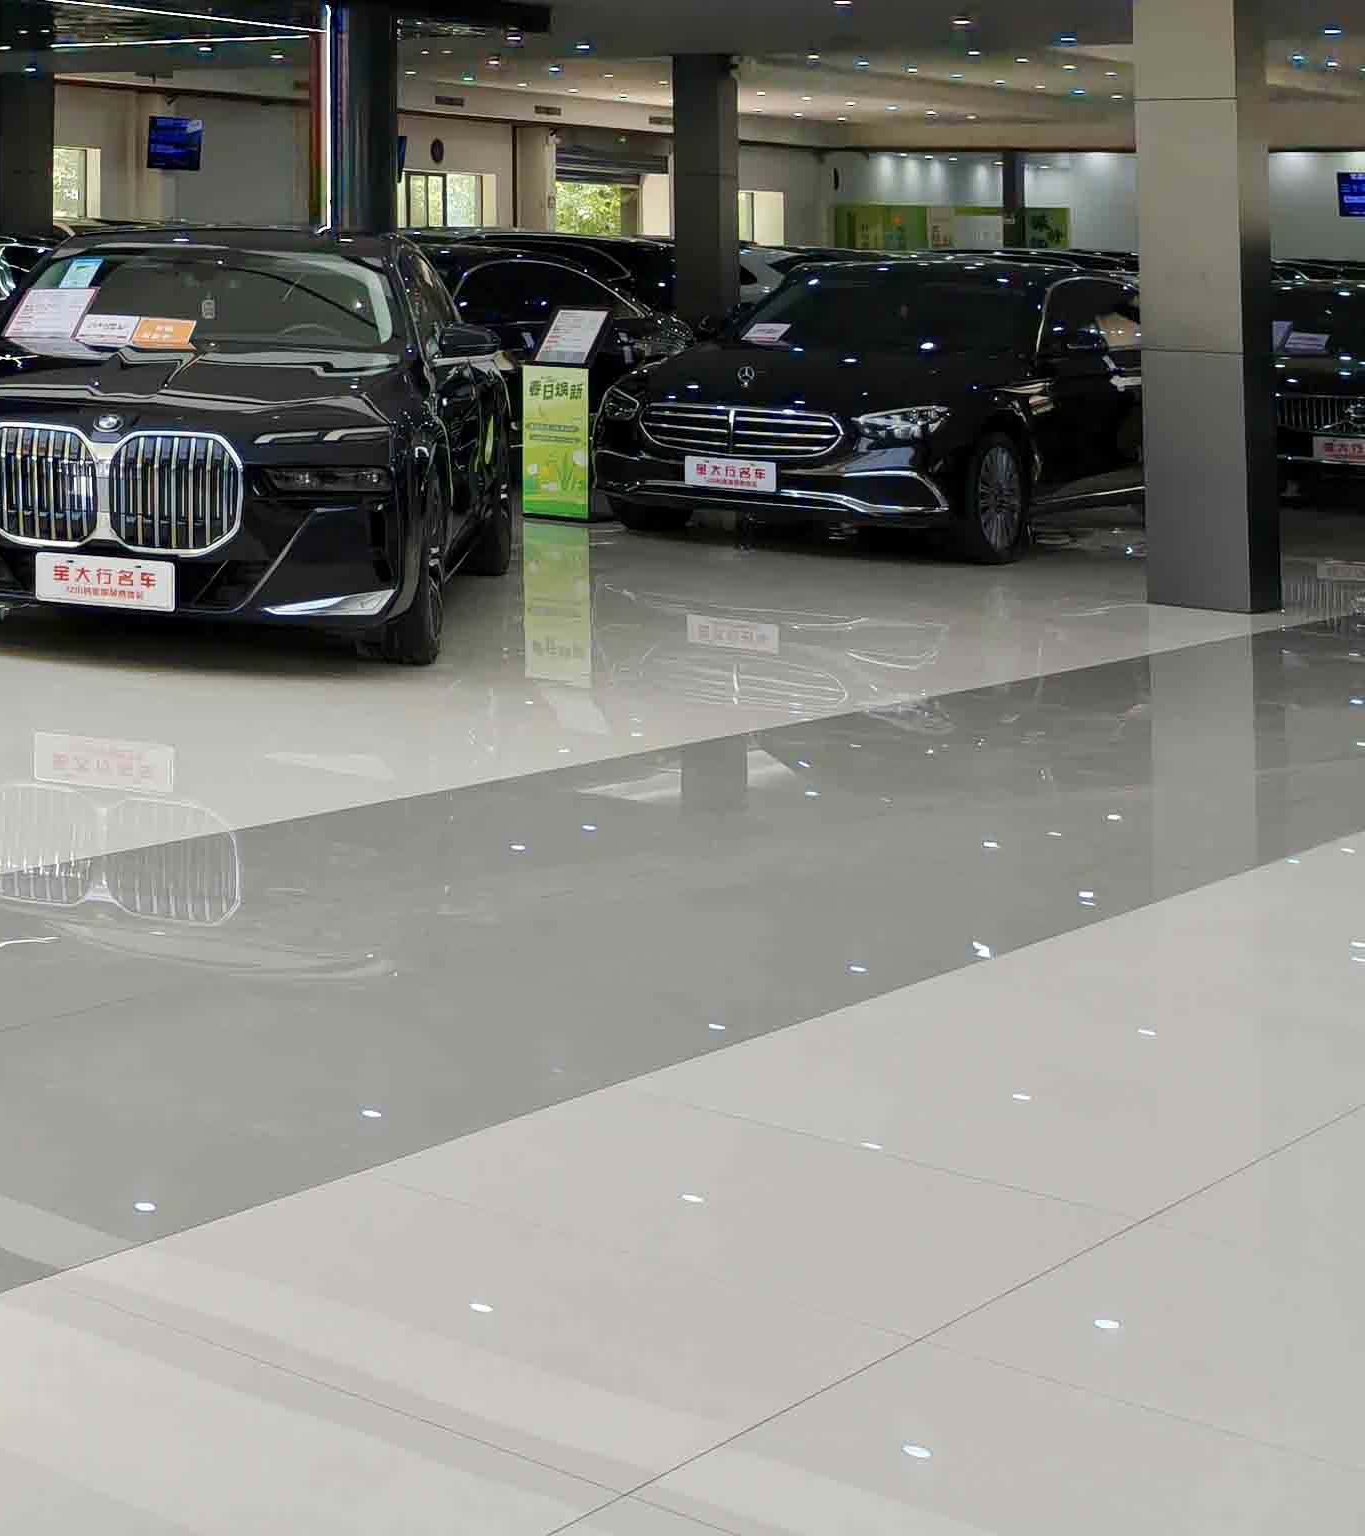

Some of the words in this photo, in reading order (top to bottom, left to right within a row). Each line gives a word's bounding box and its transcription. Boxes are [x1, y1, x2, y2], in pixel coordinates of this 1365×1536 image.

[52, 564, 158, 589] 宝大行名车
